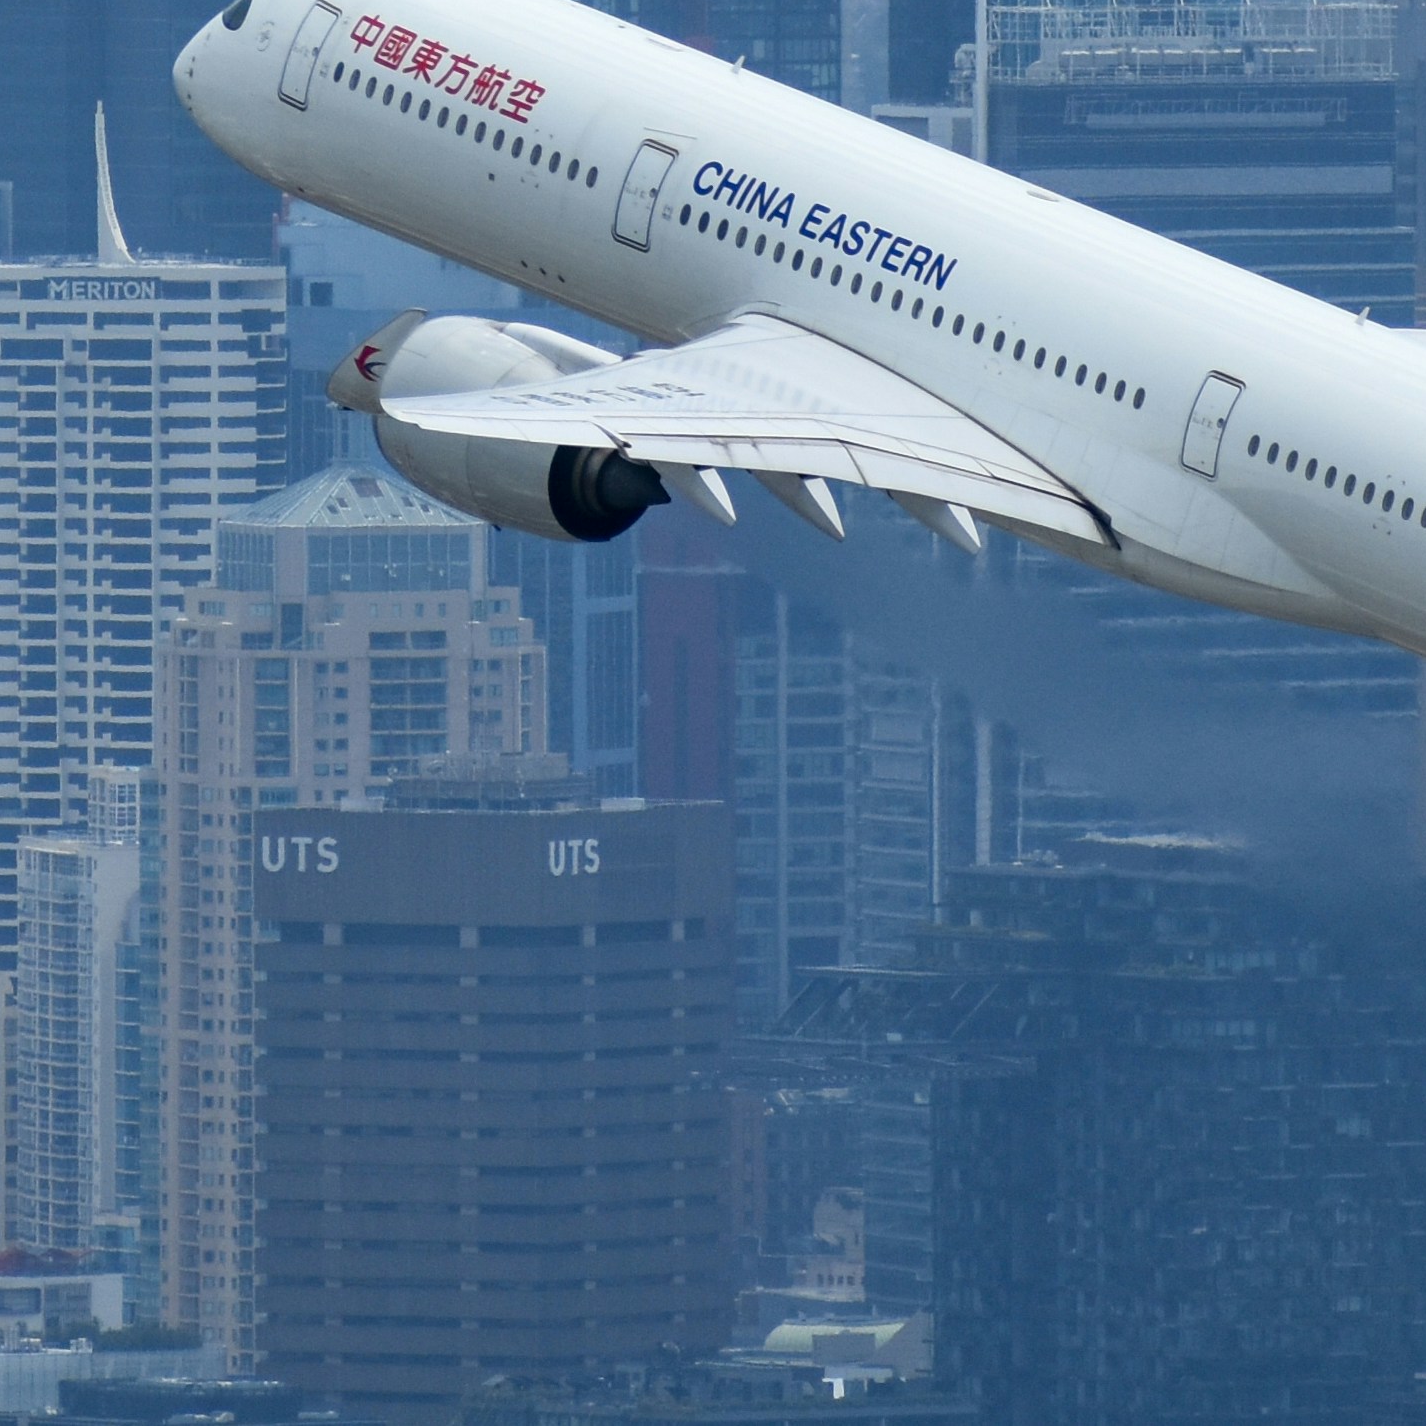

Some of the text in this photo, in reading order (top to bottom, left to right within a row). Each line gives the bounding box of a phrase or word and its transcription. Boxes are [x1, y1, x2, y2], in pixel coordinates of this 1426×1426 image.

[350, 14, 547, 125] 中國東方航空
[692, 160, 959, 292] CHINA EASTERN
[47, 279, 156, 301] MERITON
[261, 835, 340, 874] UTS
[548, 837, 601, 878] UTS
